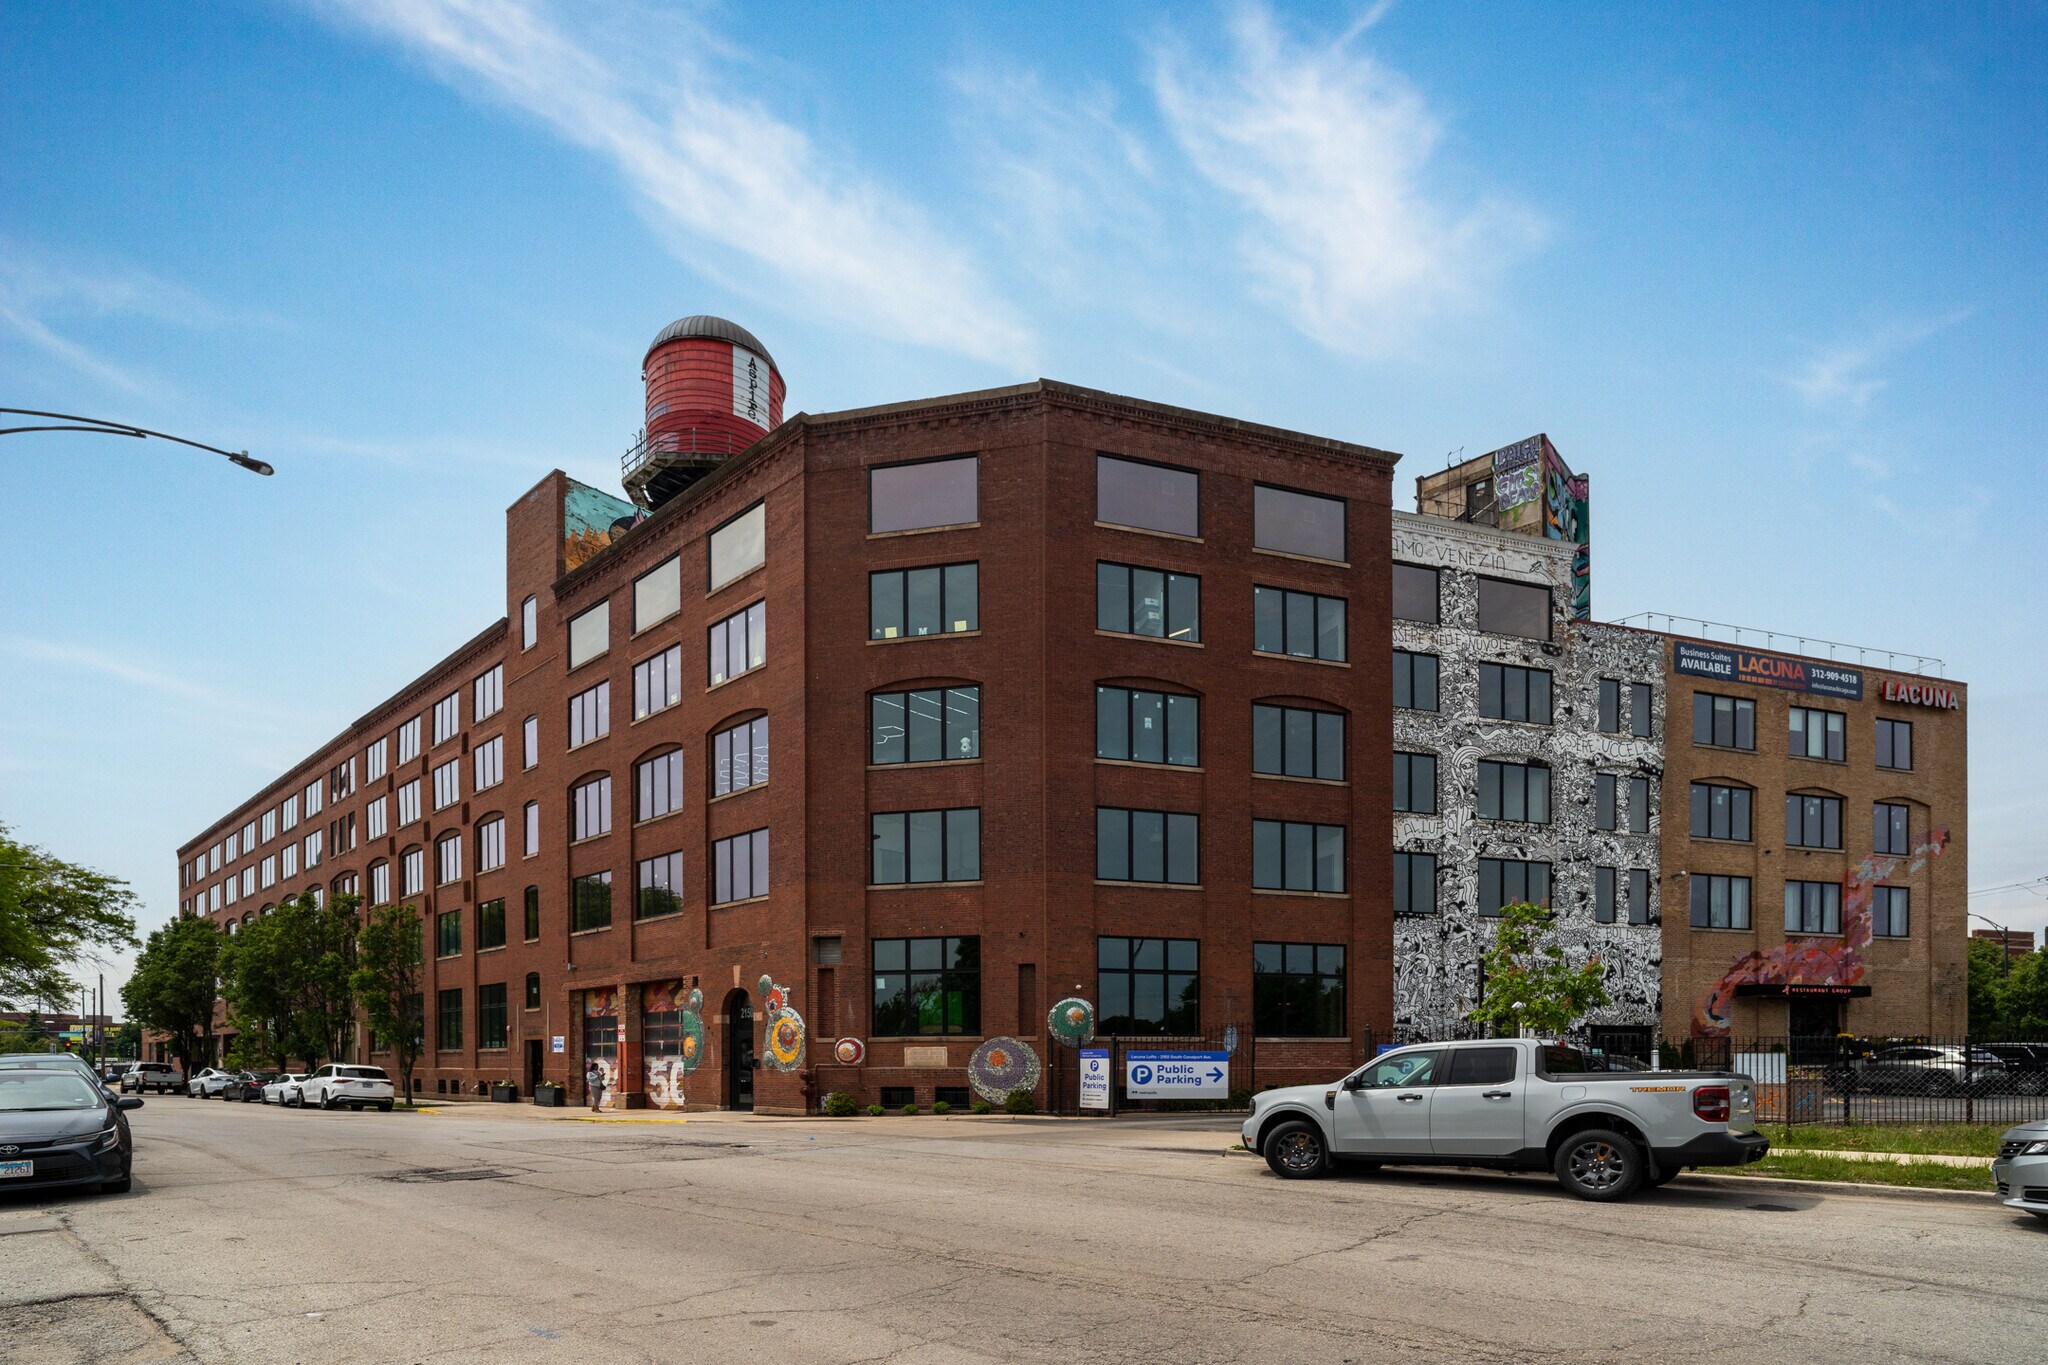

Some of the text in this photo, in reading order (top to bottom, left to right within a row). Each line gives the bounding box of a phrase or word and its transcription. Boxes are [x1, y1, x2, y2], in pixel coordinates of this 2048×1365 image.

[1435, 545, 1505, 570] VENEZIA
[1469, 639, 1511, 652] NUVOLE
[1680, 647, 1731, 662] Business Suites
[1681, 658, 1731, 675] AVAILABLE
[1738, 655, 1805, 681] LACUNA
[1811, 668, 1857, 684] 312-909-4518
[1883, 680, 1959, 710] LACUNA
[1558, 735, 1595, 753] ESSERE
[1421, 818, 1454, 835] LUPO
[1157, 1065, 1194, 1074] Public
[1083, 1082, 1107, 1090] Parking
[1157, 1075, 1202, 1086] Parking
